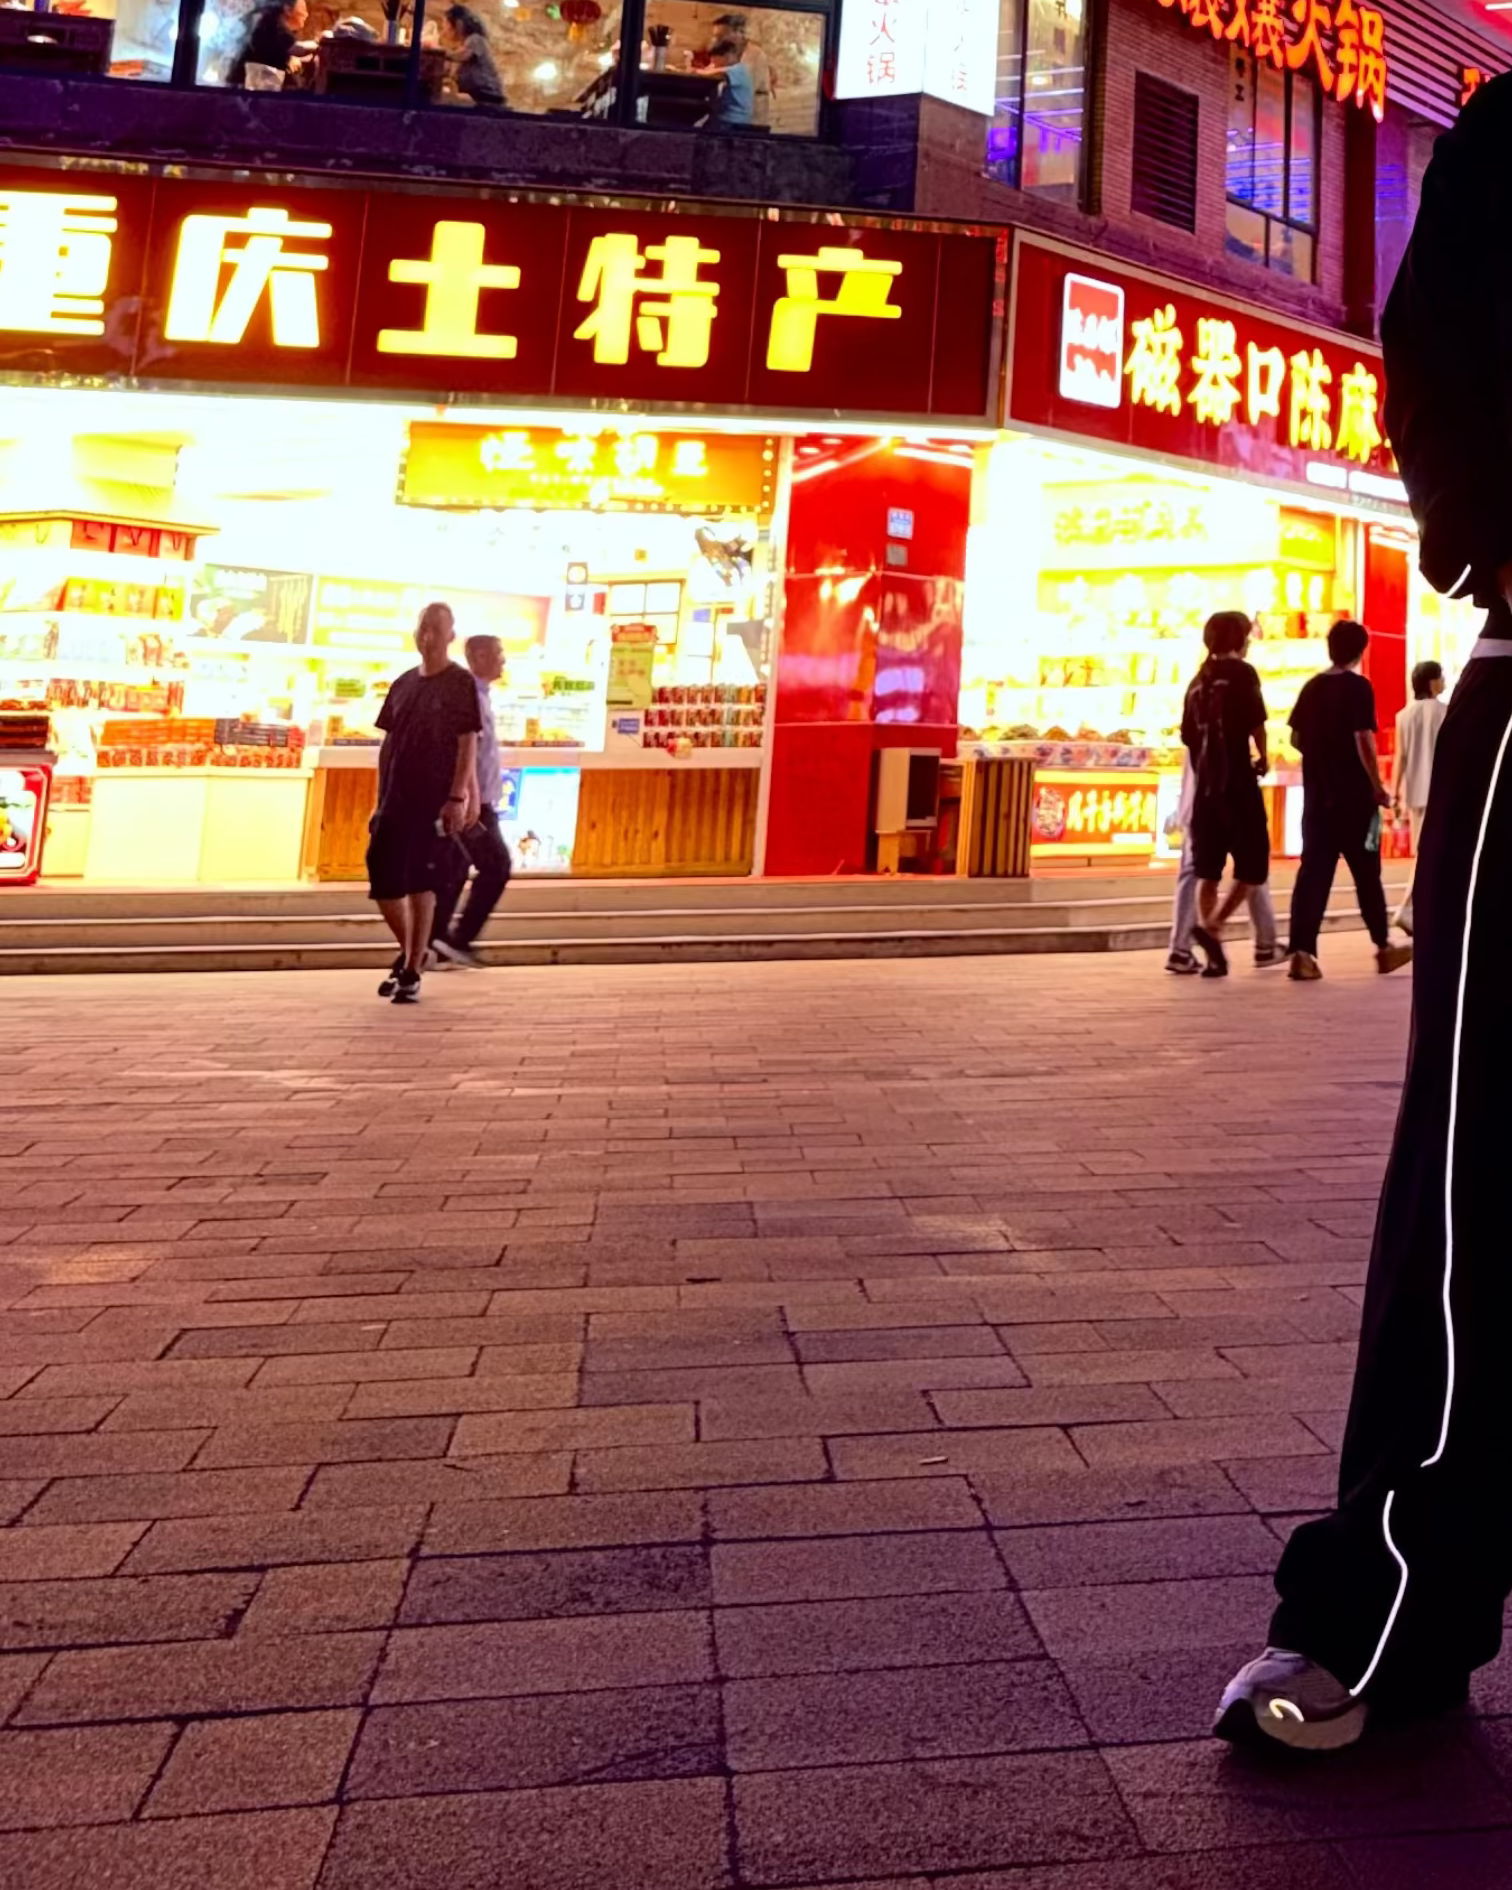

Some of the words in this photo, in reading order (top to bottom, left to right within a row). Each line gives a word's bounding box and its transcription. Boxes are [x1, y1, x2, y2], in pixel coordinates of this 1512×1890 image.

[1124, 303, 1392, 462] 磁器口陈麻
